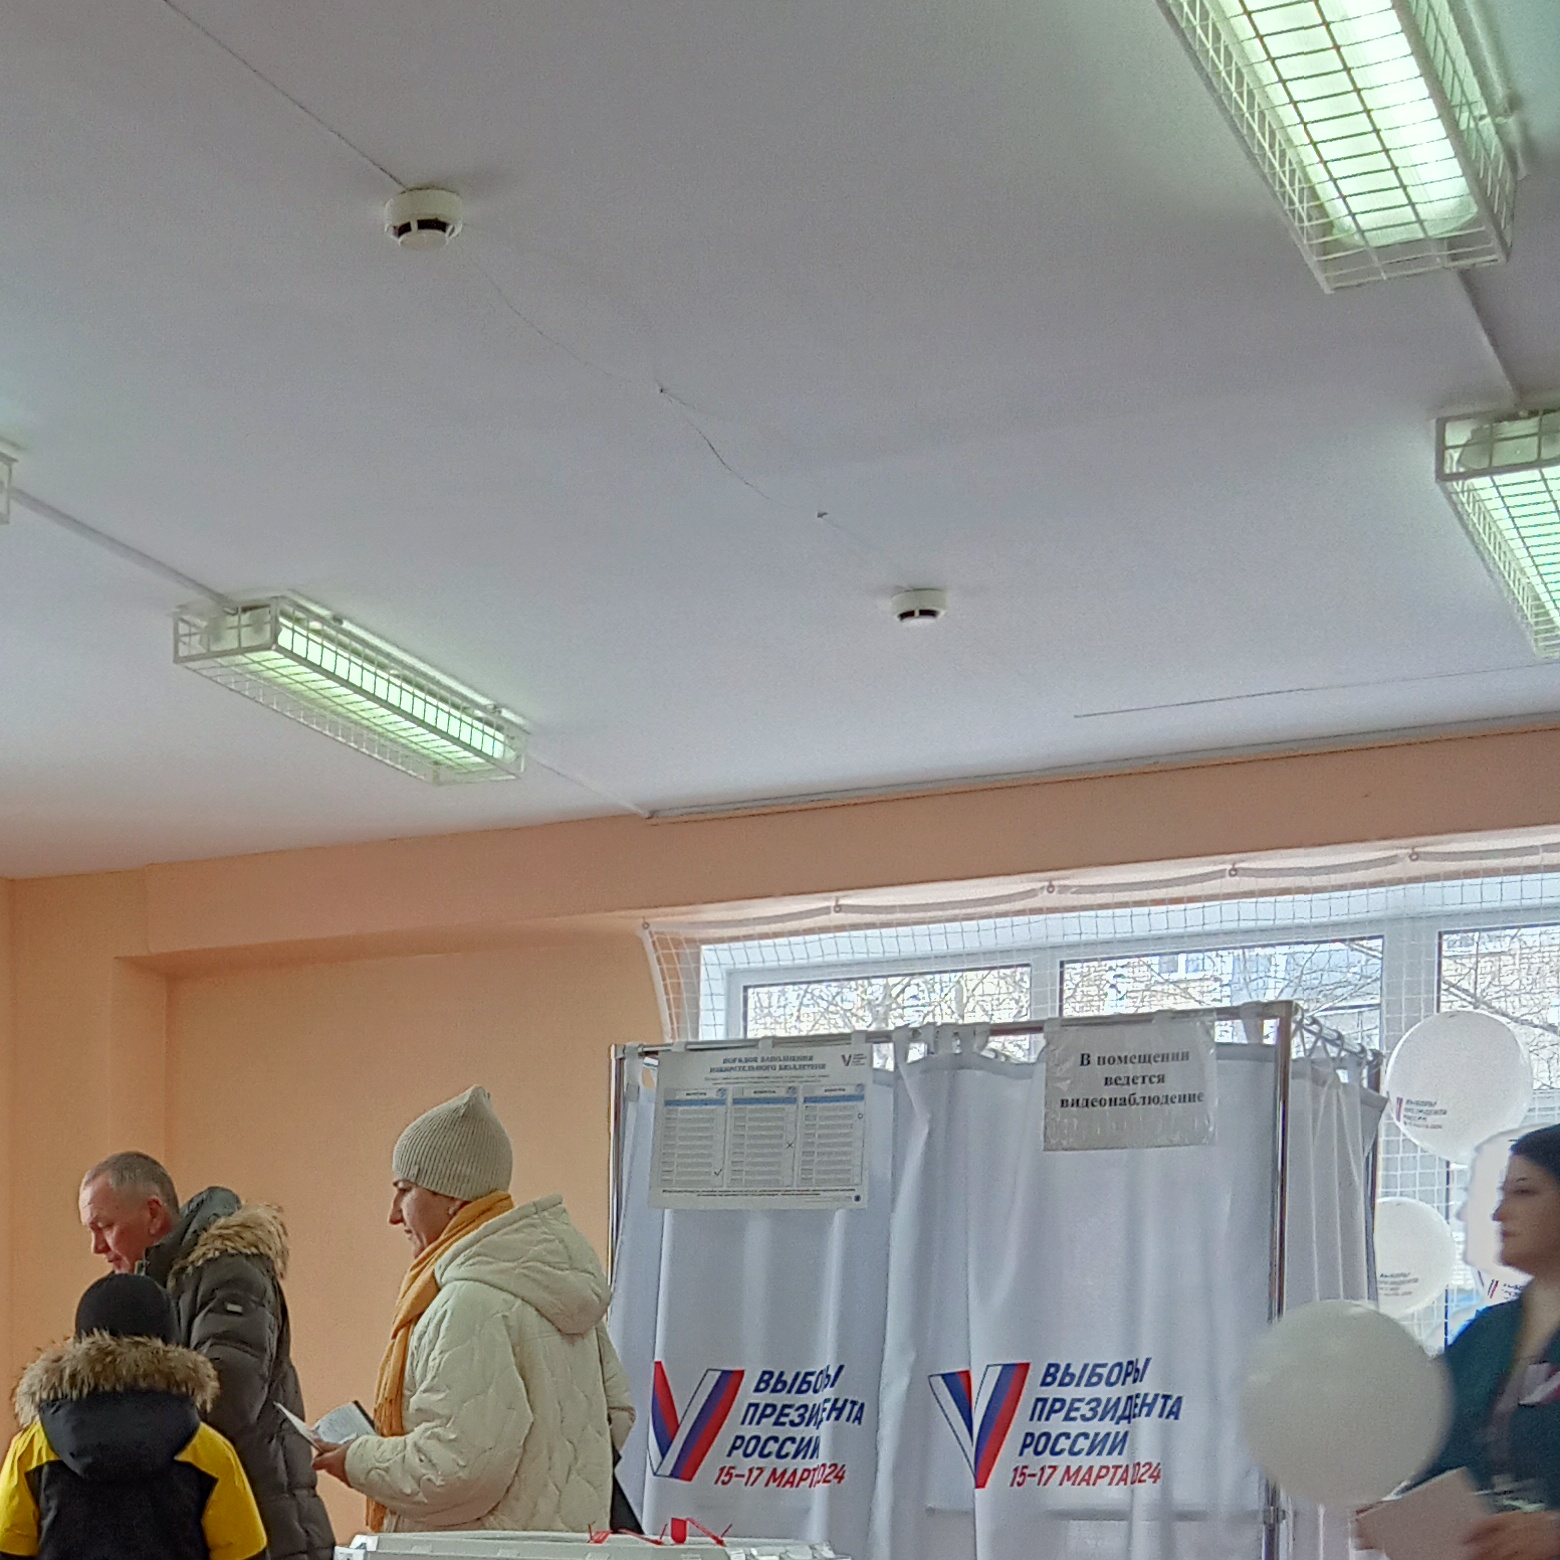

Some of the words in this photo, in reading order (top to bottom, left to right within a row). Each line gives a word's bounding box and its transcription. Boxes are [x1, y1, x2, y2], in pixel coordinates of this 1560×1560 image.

[1080, 1052, 1091, 1067] В
[1096, 1050, 1190, 1067] помещении
[1103, 1073, 1166, 1087] ведется
[1059, 1091, 1205, 1109] видеонаблюдение
[1039, 1357, 1152, 1388] ВЫБОРЫ
[1028, 1392, 1184, 1425] ПРЕЗИДЕНТА
[1018, 1431, 1130, 1457] РОССИИ
